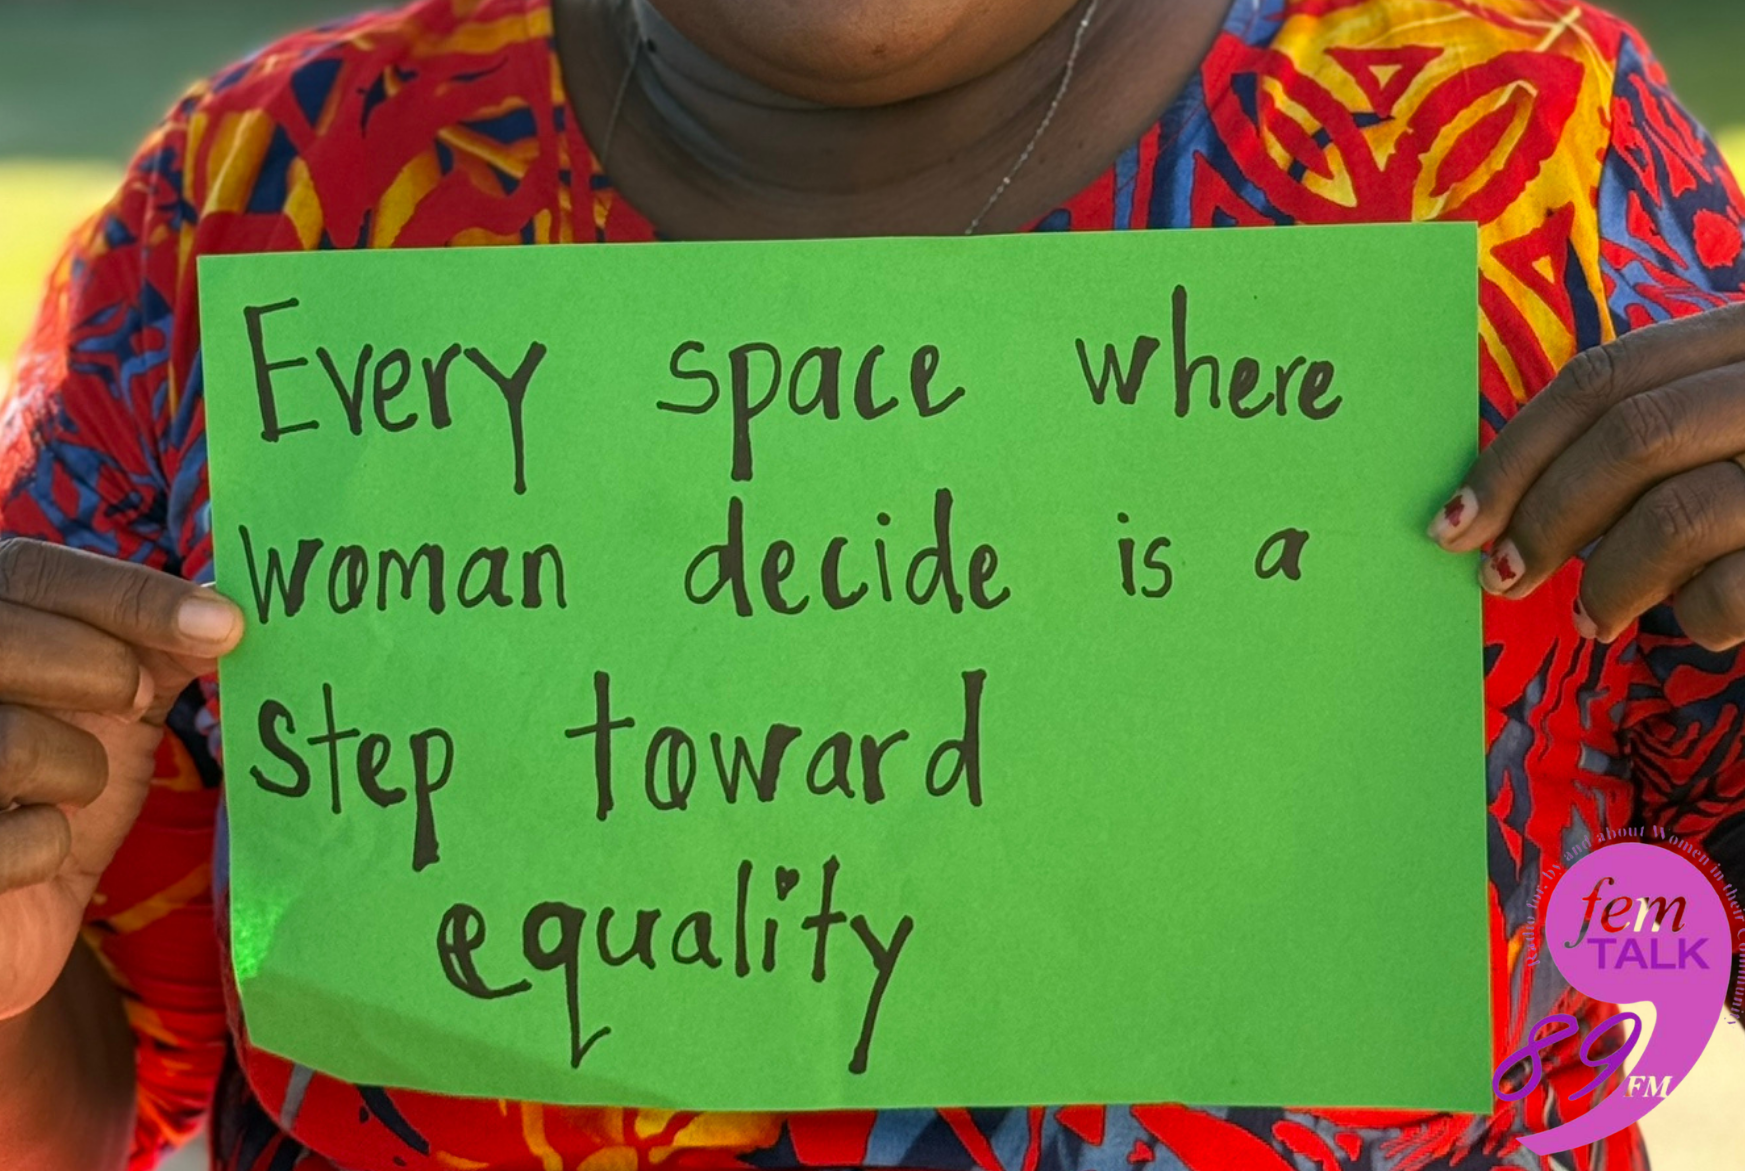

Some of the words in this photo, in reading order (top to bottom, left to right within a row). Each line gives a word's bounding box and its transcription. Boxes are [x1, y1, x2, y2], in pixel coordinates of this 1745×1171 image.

[244, 298, 546, 494] Every
[657, 340, 966, 482] space
[1075, 285, 1343, 420] where
[685, 488, 1010, 618] decide
[1117, 512, 1172, 598] is
[1255, 527, 1310, 581] a
[564, 669, 986, 821] toward
[436, 856, 913, 1074] equality
